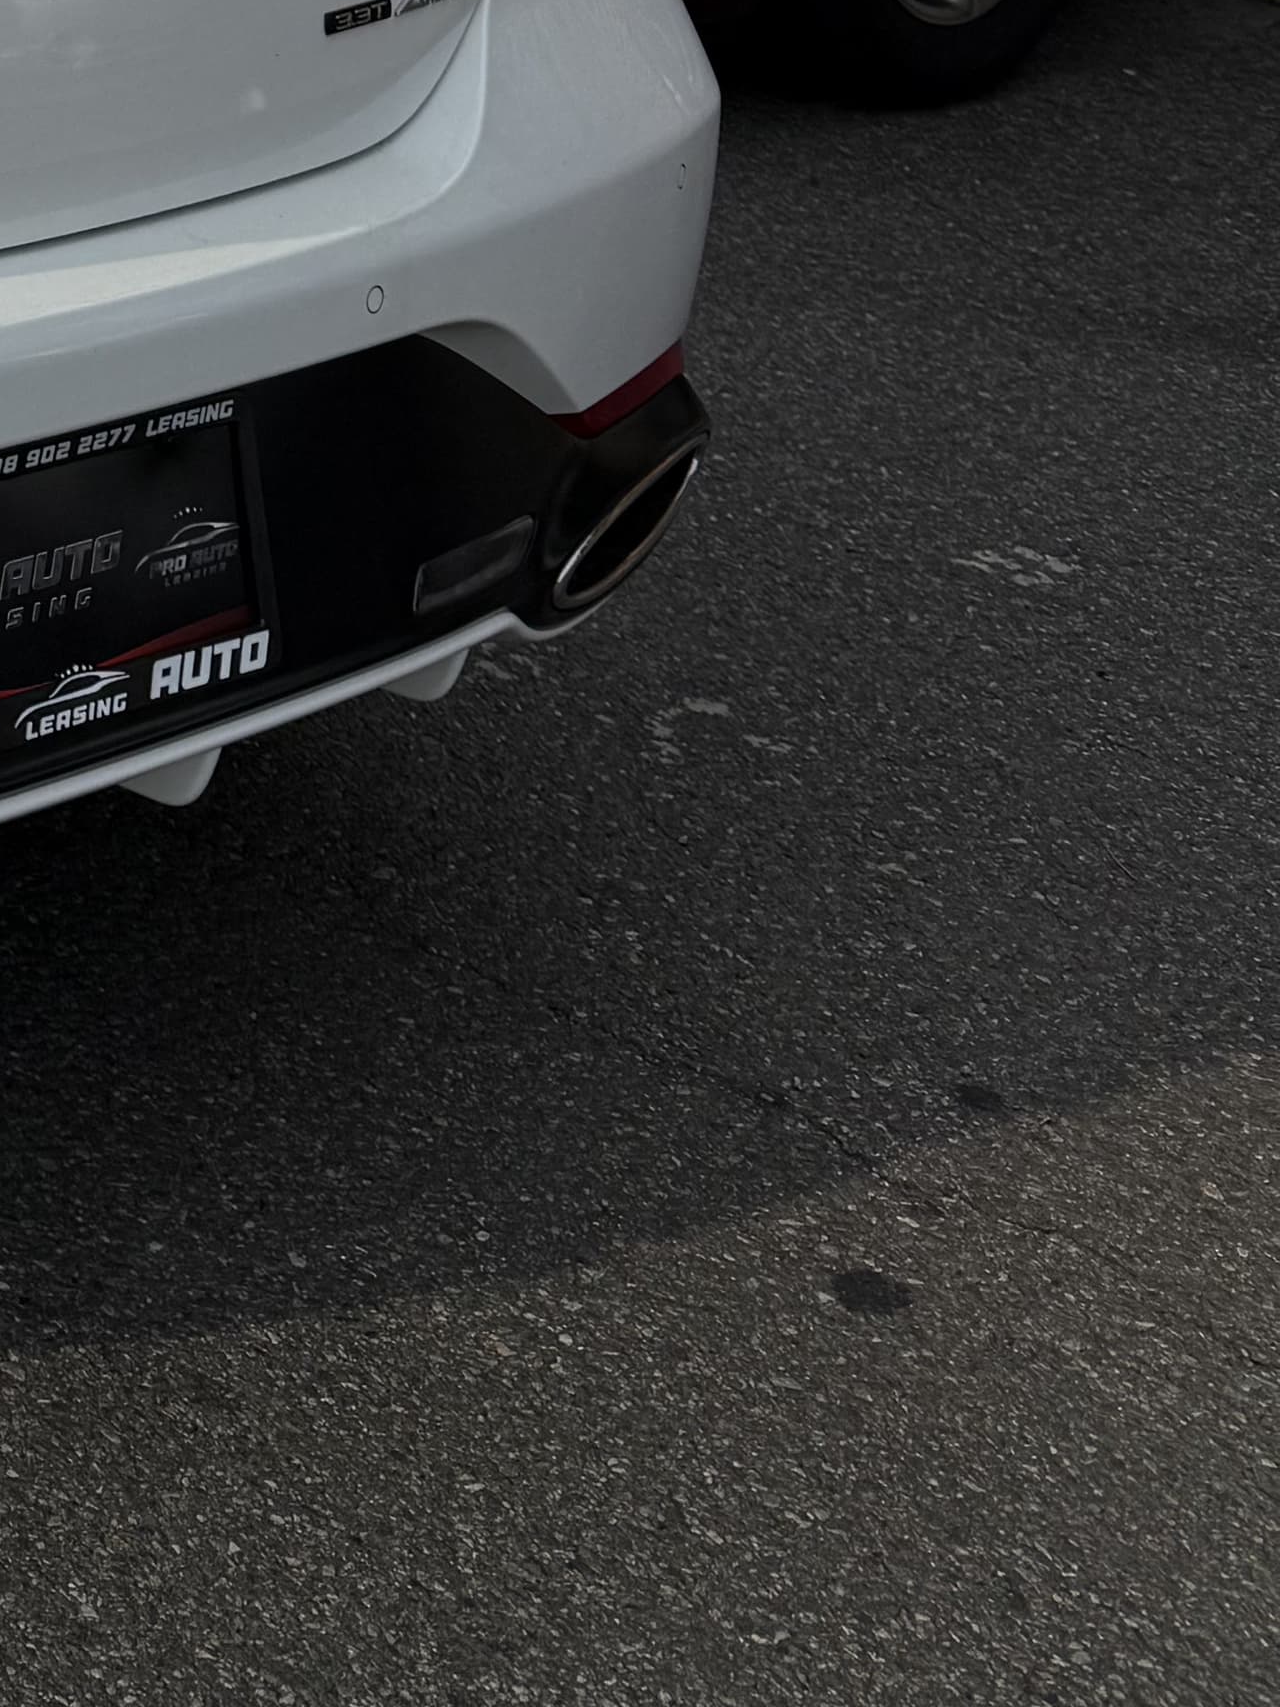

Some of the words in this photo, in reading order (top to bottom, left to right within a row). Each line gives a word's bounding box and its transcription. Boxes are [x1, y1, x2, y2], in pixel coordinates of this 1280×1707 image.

[25, 441, 72, 470] 902
[77, 424, 137, 457] 2277
[145, 400, 235, 438] LEASING
[25, 692, 128, 741] LEASING
[149, 629, 270, 701] AUTO
